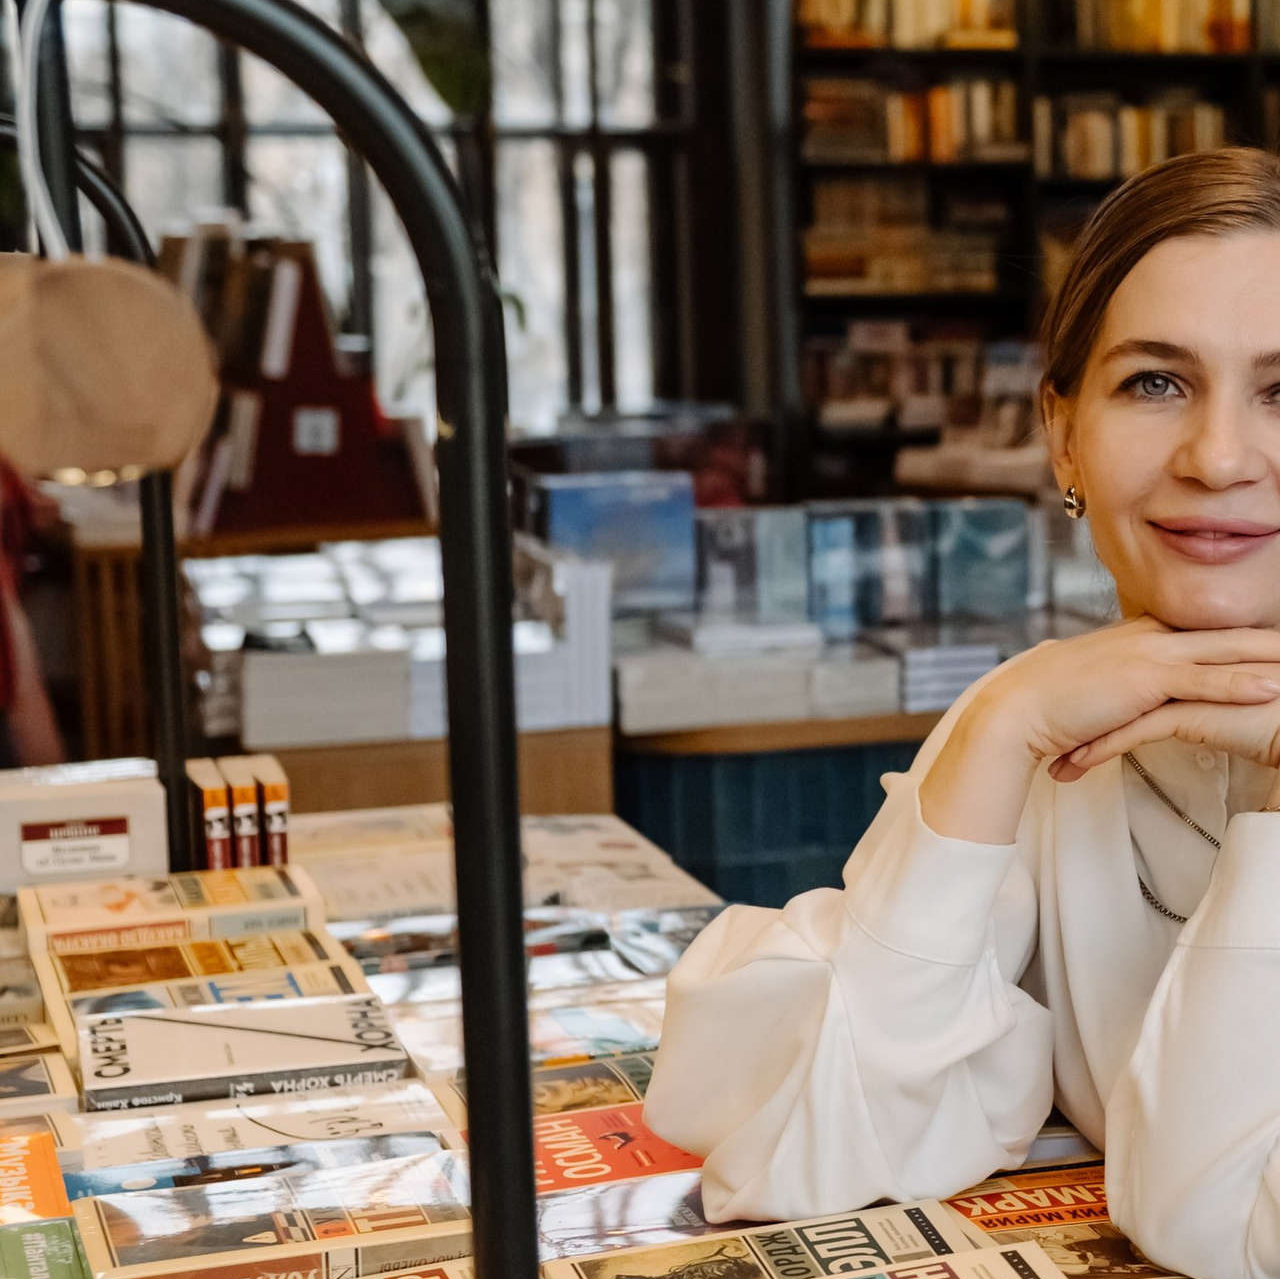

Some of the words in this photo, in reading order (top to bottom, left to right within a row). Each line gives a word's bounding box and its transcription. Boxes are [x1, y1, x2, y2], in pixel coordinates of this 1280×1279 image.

[270, 1075, 328, 1093] ХОРНА
[329, 1069, 399, 1088] СМЕРТЬ
[538, 1118, 612, 1179] ОСМАН
[955, 1183, 1107, 1216] ЕМАРК
[980, 1211, 1065, 1229] МАРИЯ
[1065, 1205, 1109, 1220] РИХ
[802, 1220, 888, 1274] ЭЛЛ
